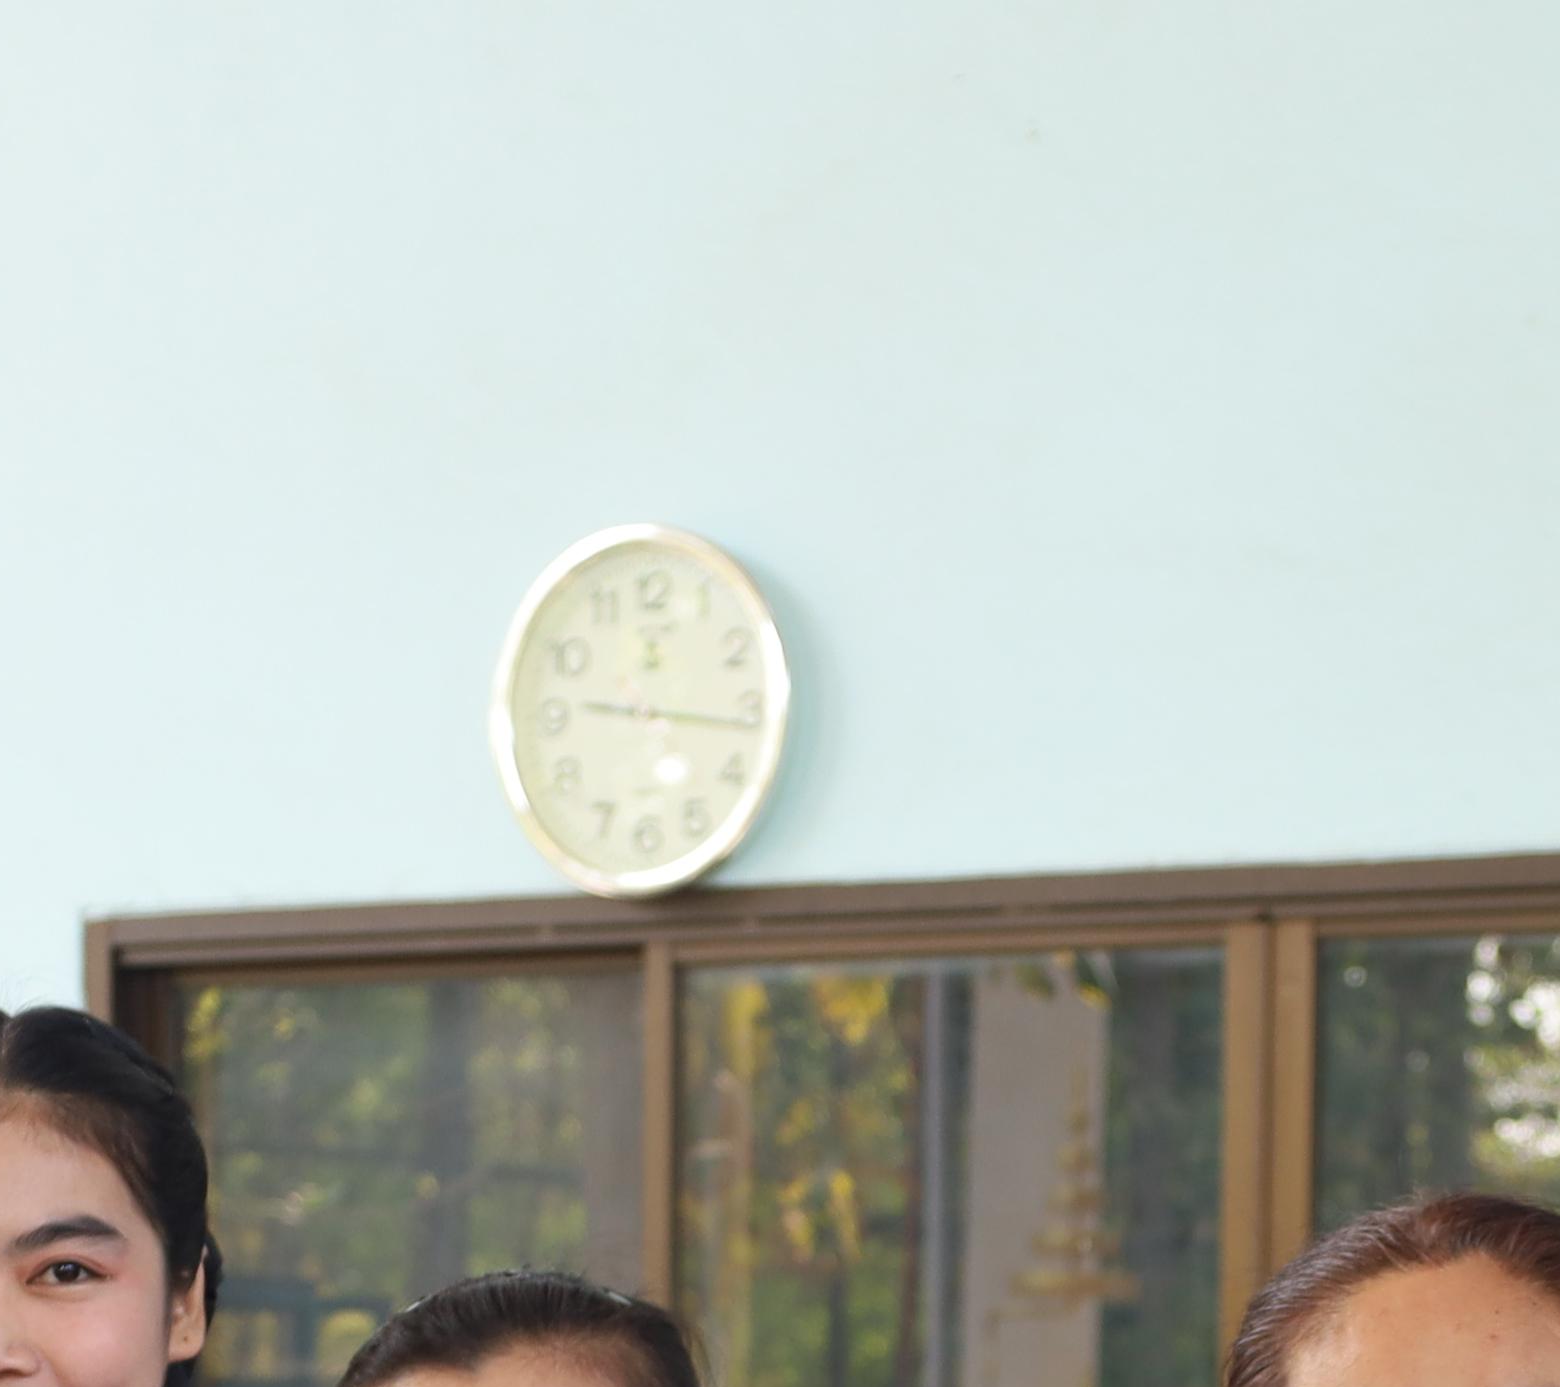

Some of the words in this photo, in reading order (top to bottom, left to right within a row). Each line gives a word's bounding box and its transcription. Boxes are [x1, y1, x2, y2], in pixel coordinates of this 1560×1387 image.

[589, 583, 620, 625] 11
[637, 569, 673, 612] 12
[544, 636, 592, 678] 10
[721, 625, 754, 669] 2
[540, 697, 570, 739] 9
[553, 755, 582, 796] 8
[719, 752, 744, 787] 4
[590, 800, 616, 839] 7
[633, 814, 665, 854] 6
[682, 796, 710, 838] 5
